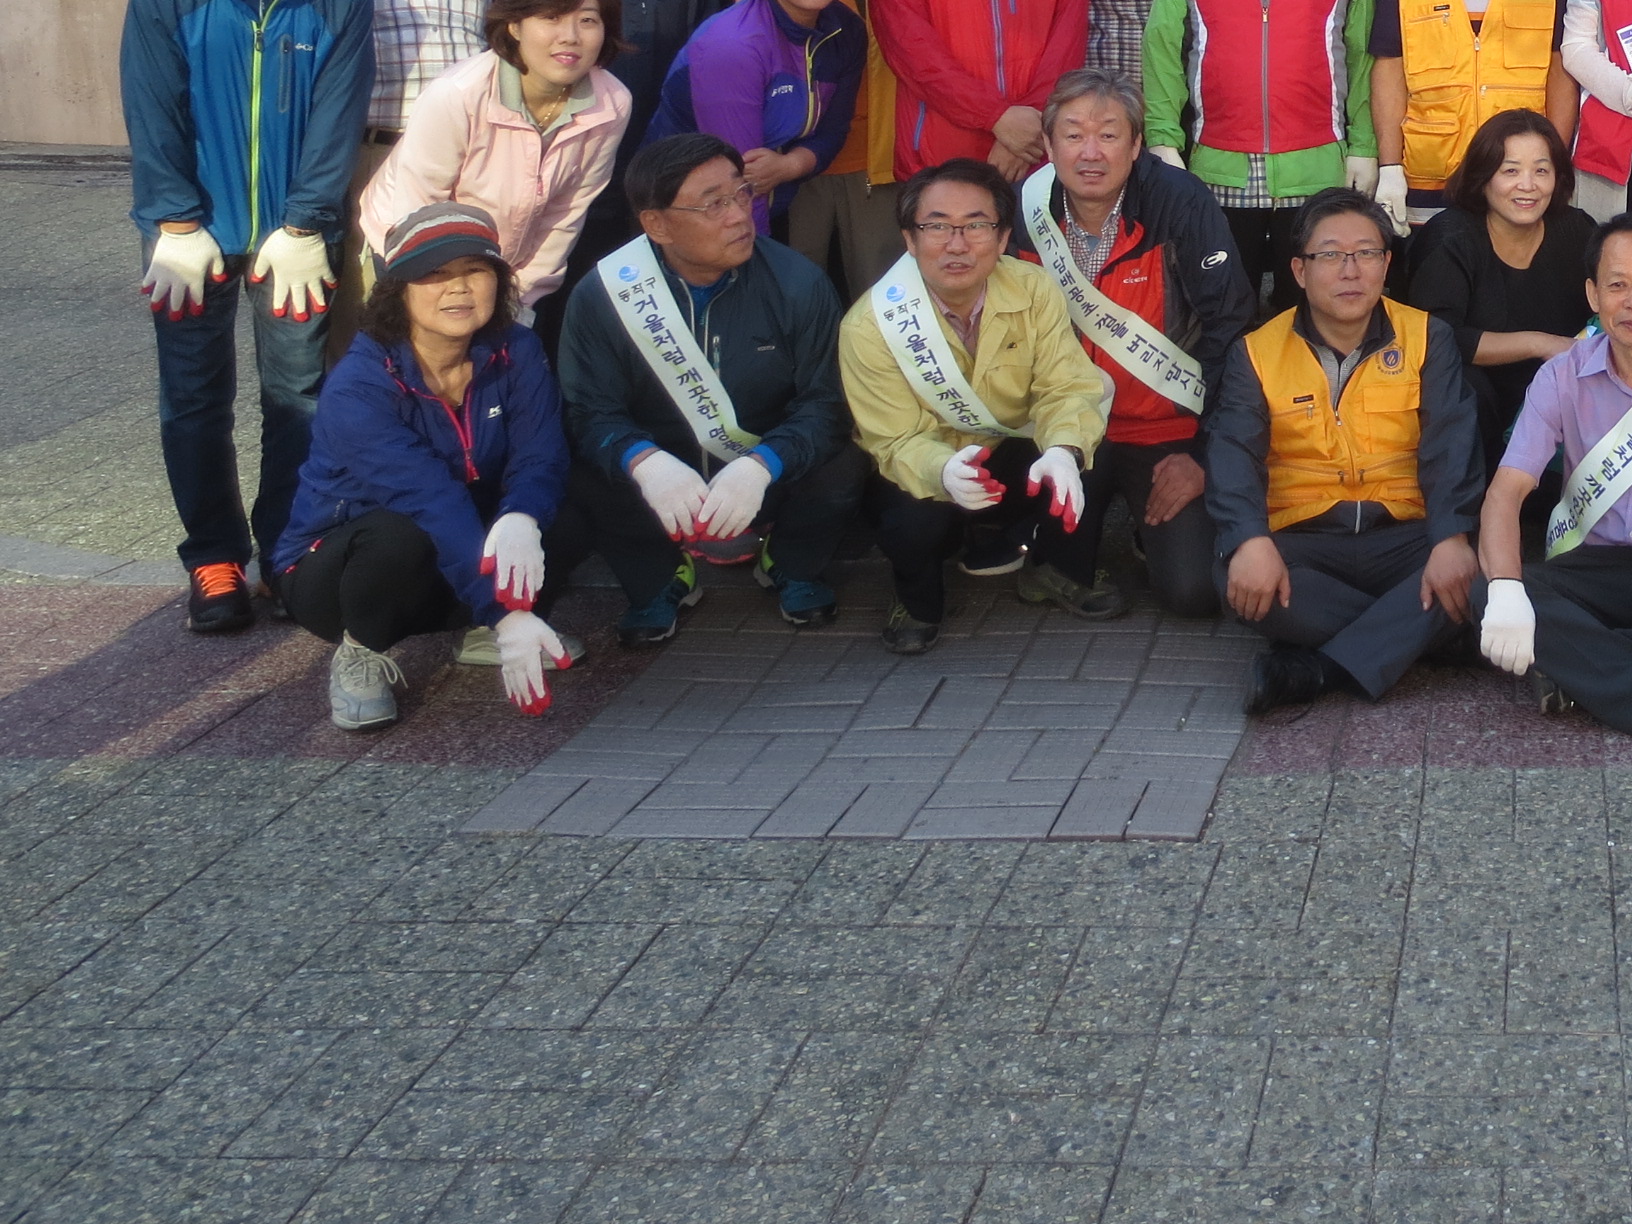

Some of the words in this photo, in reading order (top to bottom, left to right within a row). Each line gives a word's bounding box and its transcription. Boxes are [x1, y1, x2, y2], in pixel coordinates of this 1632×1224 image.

[617, 276, 657, 303] 동작구
[883, 297, 922, 322] 동작구
[634, 294, 687, 366] 거울처럼
[676, 366, 720, 421] 깨끗한
[897, 314, 947, 386] 거울처럼
[935, 387, 982, 427] 깨끗한
[1126, 333, 1170, 372] 버리지
